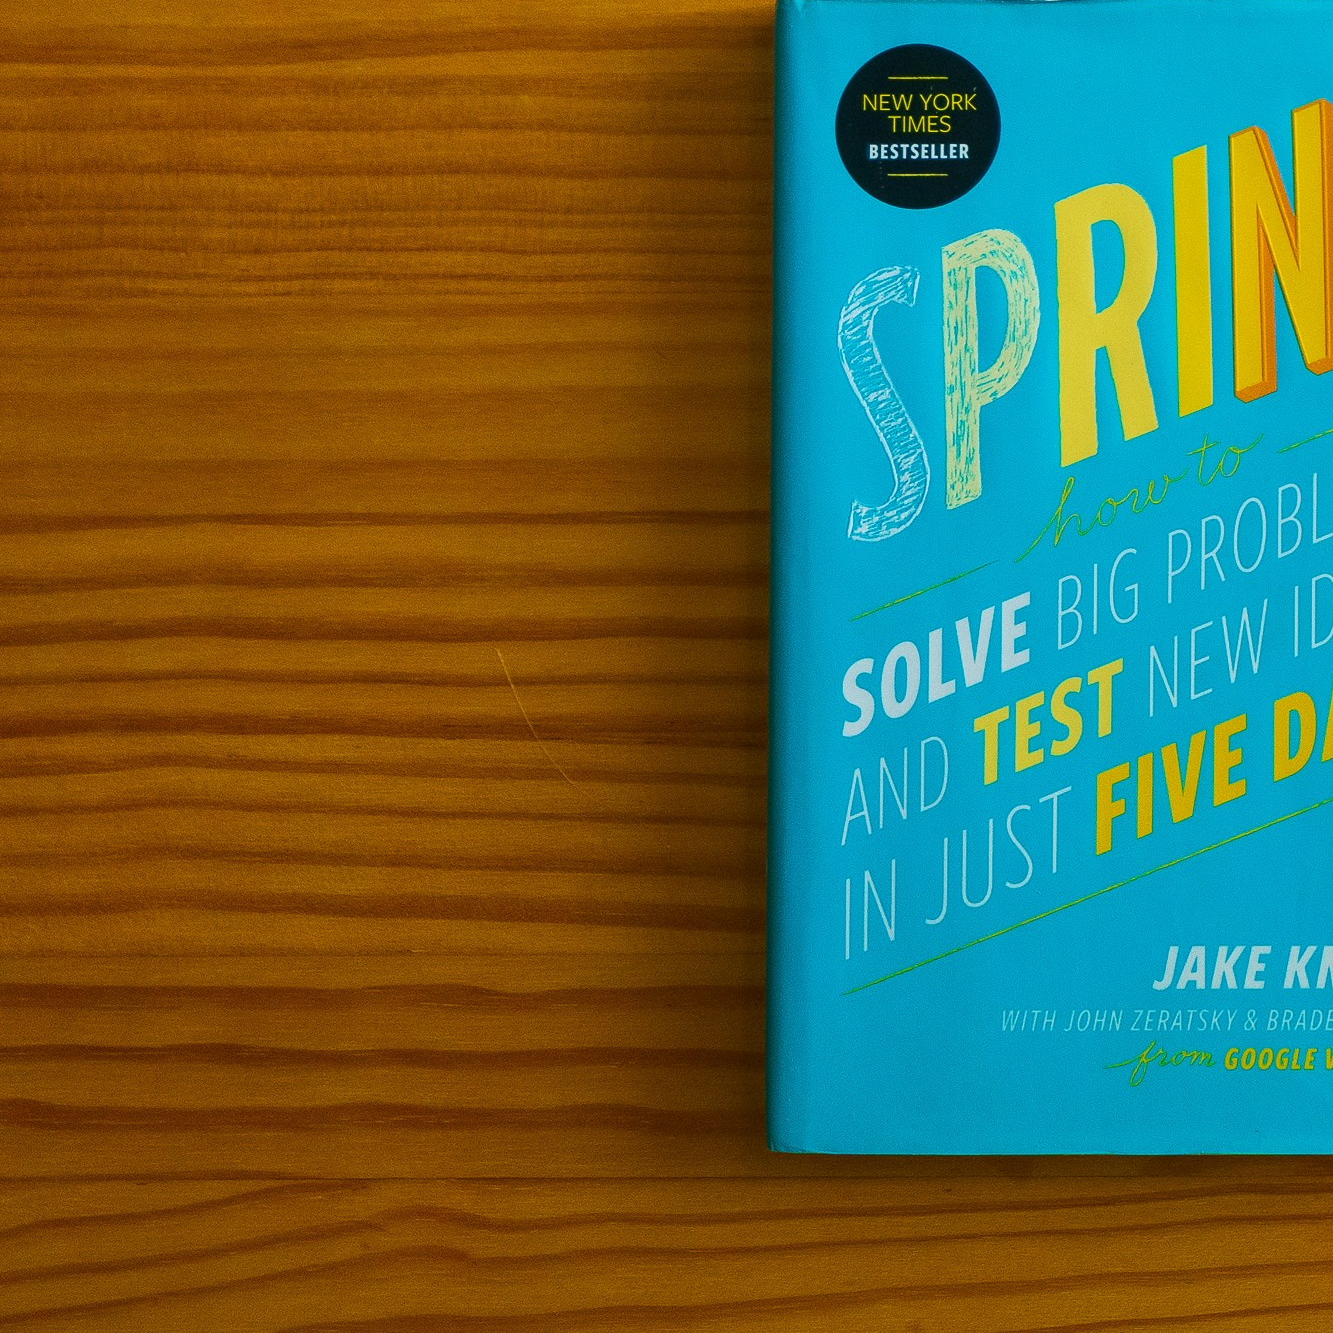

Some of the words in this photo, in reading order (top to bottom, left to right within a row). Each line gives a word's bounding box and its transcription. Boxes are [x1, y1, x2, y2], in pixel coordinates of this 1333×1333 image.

[862, 93, 914, 111] NEW
[919, 93, 977, 111] YORK
[888, 115, 952, 133] TIMES
[869, 143, 969, 159] BESTSELLER
[1014, 477, 1188, 564] how
[1186, 434, 1264, 487] to
[841, 592, 1031, 738] SOLVE
[1057, 548, 1139, 650] BIG
[841, 736, 949, 846] AND
[973, 658, 1125, 786] TEST
[1149, 598, 1268, 718] NEW
[845, 858, 896, 961] IN
[925, 786, 1072, 925] JUST
[1095, 714, 1248, 856] FIVE
[1152, 945, 1267, 990] JAKE
[1001, 1009, 1055, 1032] WITH
[1064, 1009, 1123, 1032] JOHN
[1130, 1009, 1237, 1032] ZERATSKY
[1244, 1009, 1257, 1032] &
[1105, 1040, 1216, 1087] from
[1224, 1047, 1318, 1071] GOOGLE
